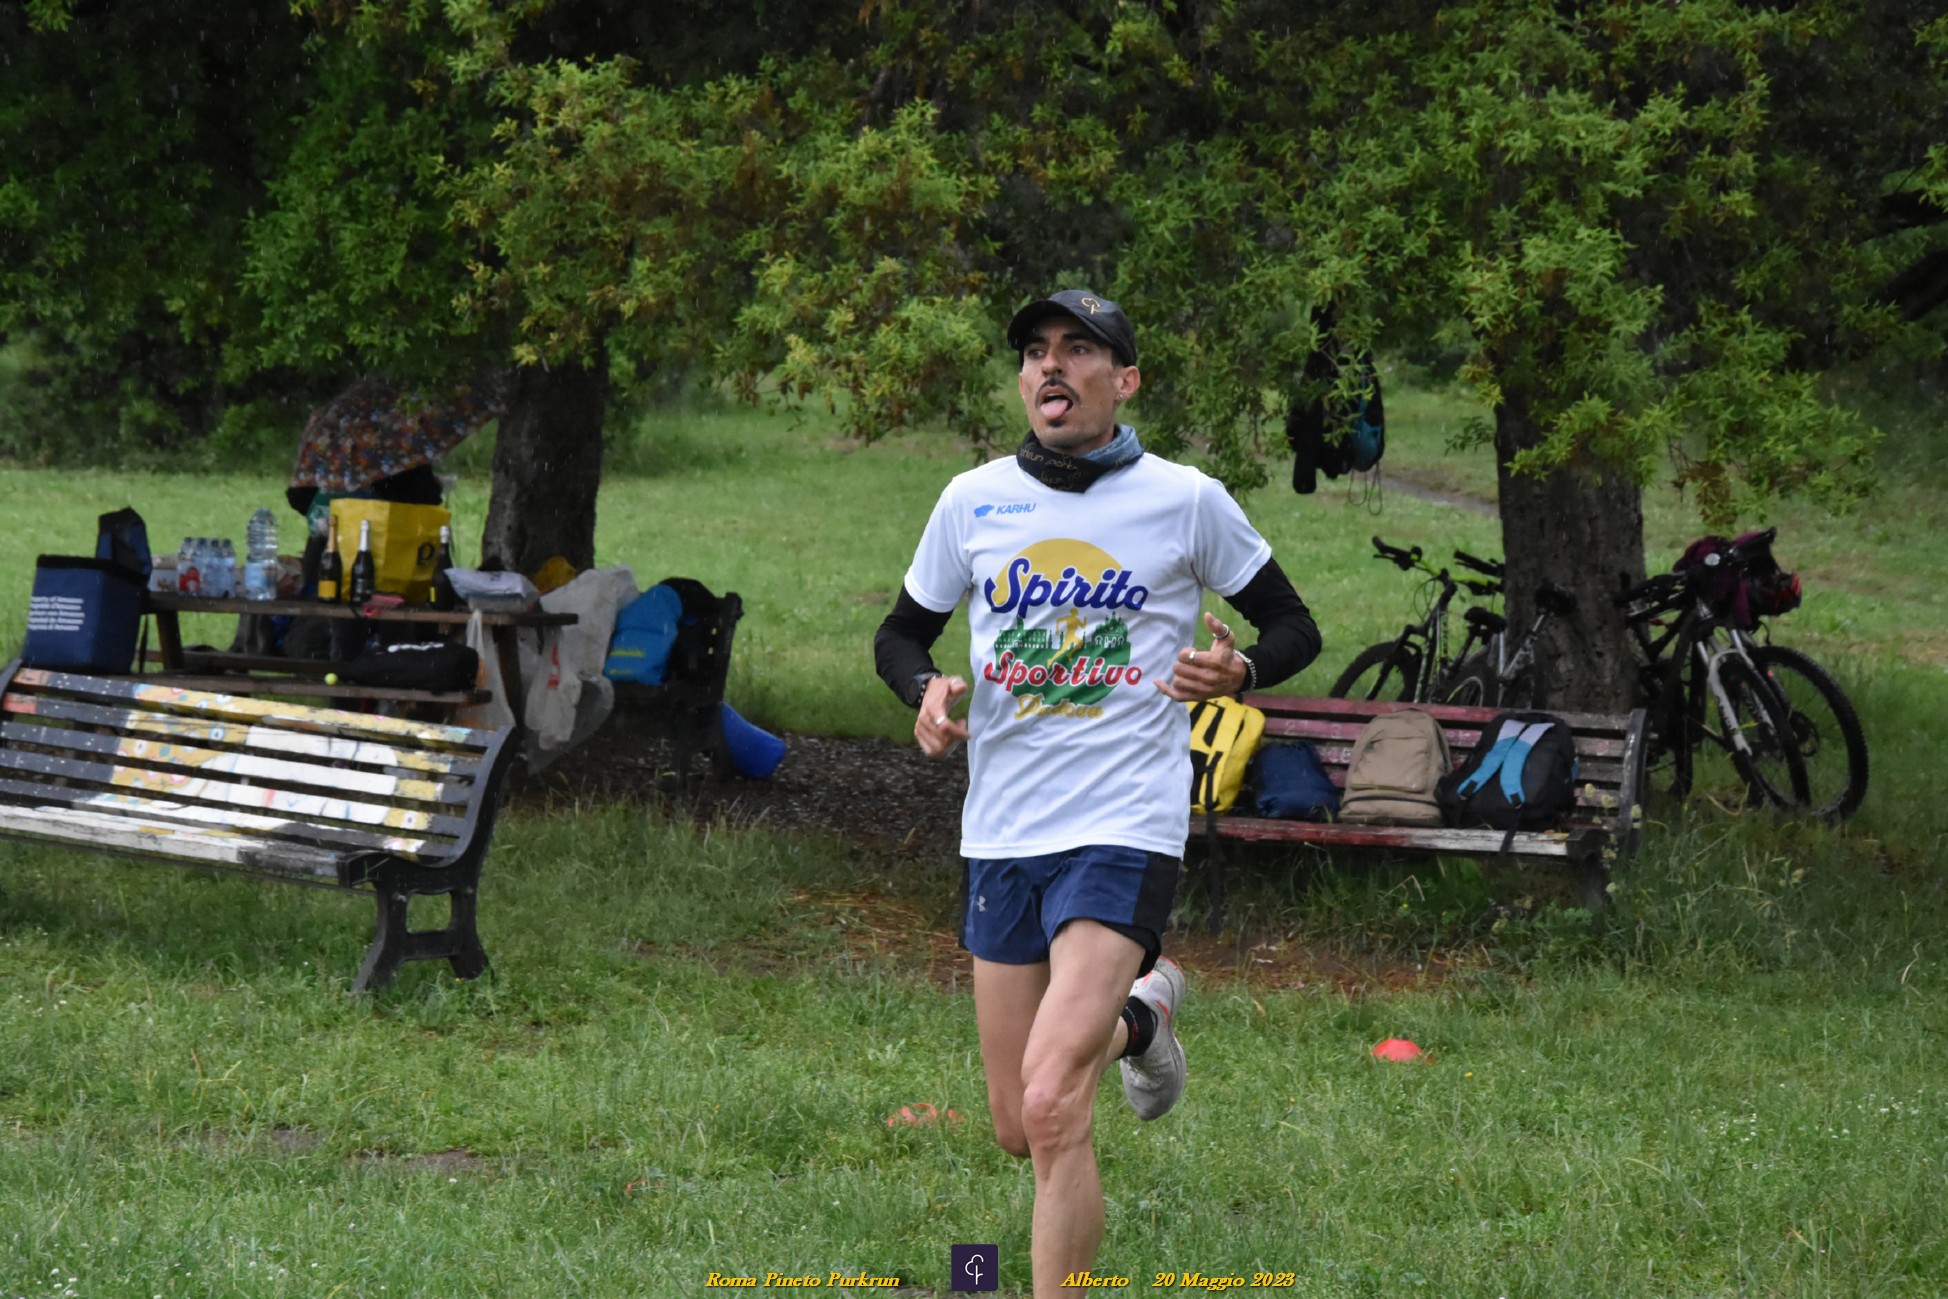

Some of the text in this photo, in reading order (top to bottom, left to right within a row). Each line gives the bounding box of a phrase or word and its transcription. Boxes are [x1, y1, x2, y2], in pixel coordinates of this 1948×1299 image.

[996, 503, 1037, 514] KARHU
[983, 557, 1149, 619] Spirito
[983, 650, 1143, 692] Sportivo
